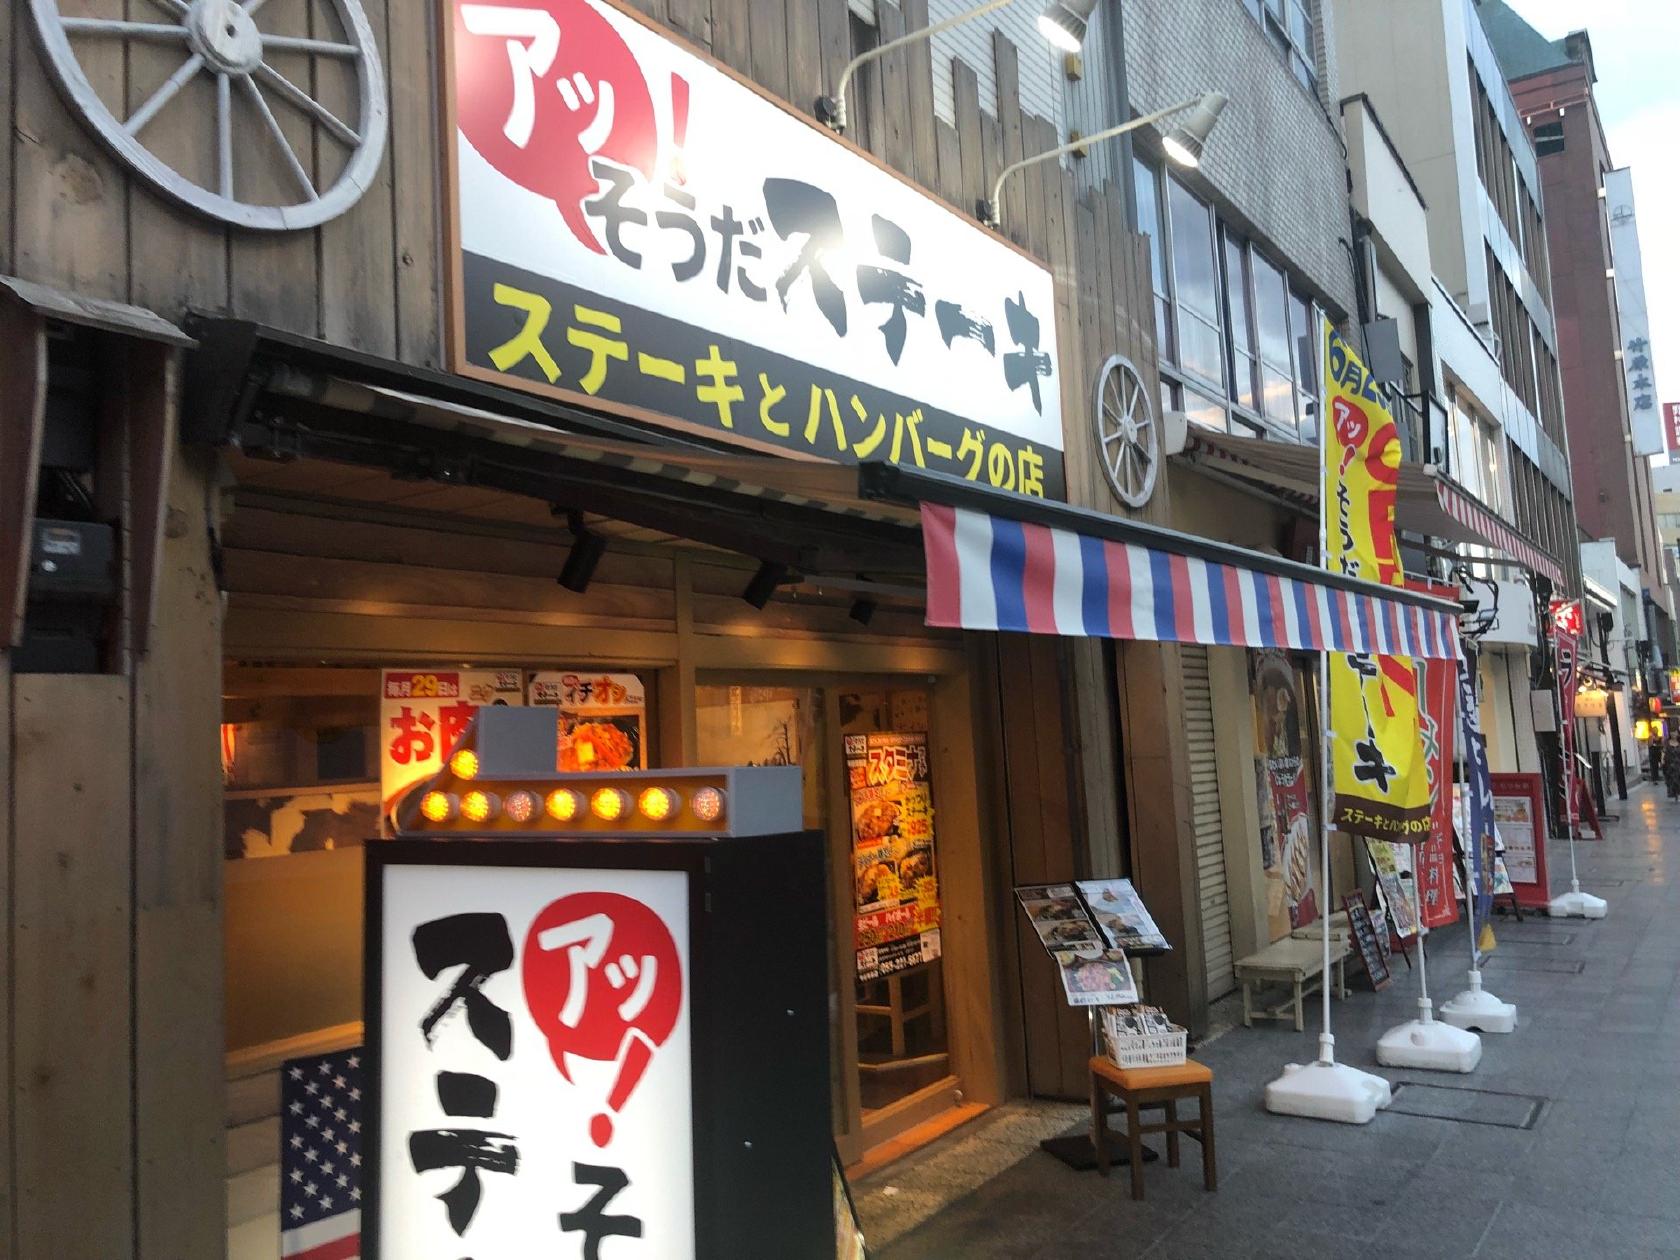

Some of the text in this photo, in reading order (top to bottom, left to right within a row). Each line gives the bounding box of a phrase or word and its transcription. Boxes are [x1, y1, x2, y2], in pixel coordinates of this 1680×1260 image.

[487, 282, 1044, 499] ステーキとハンバーグの店
[408, 911, 520, 1260] ステ
